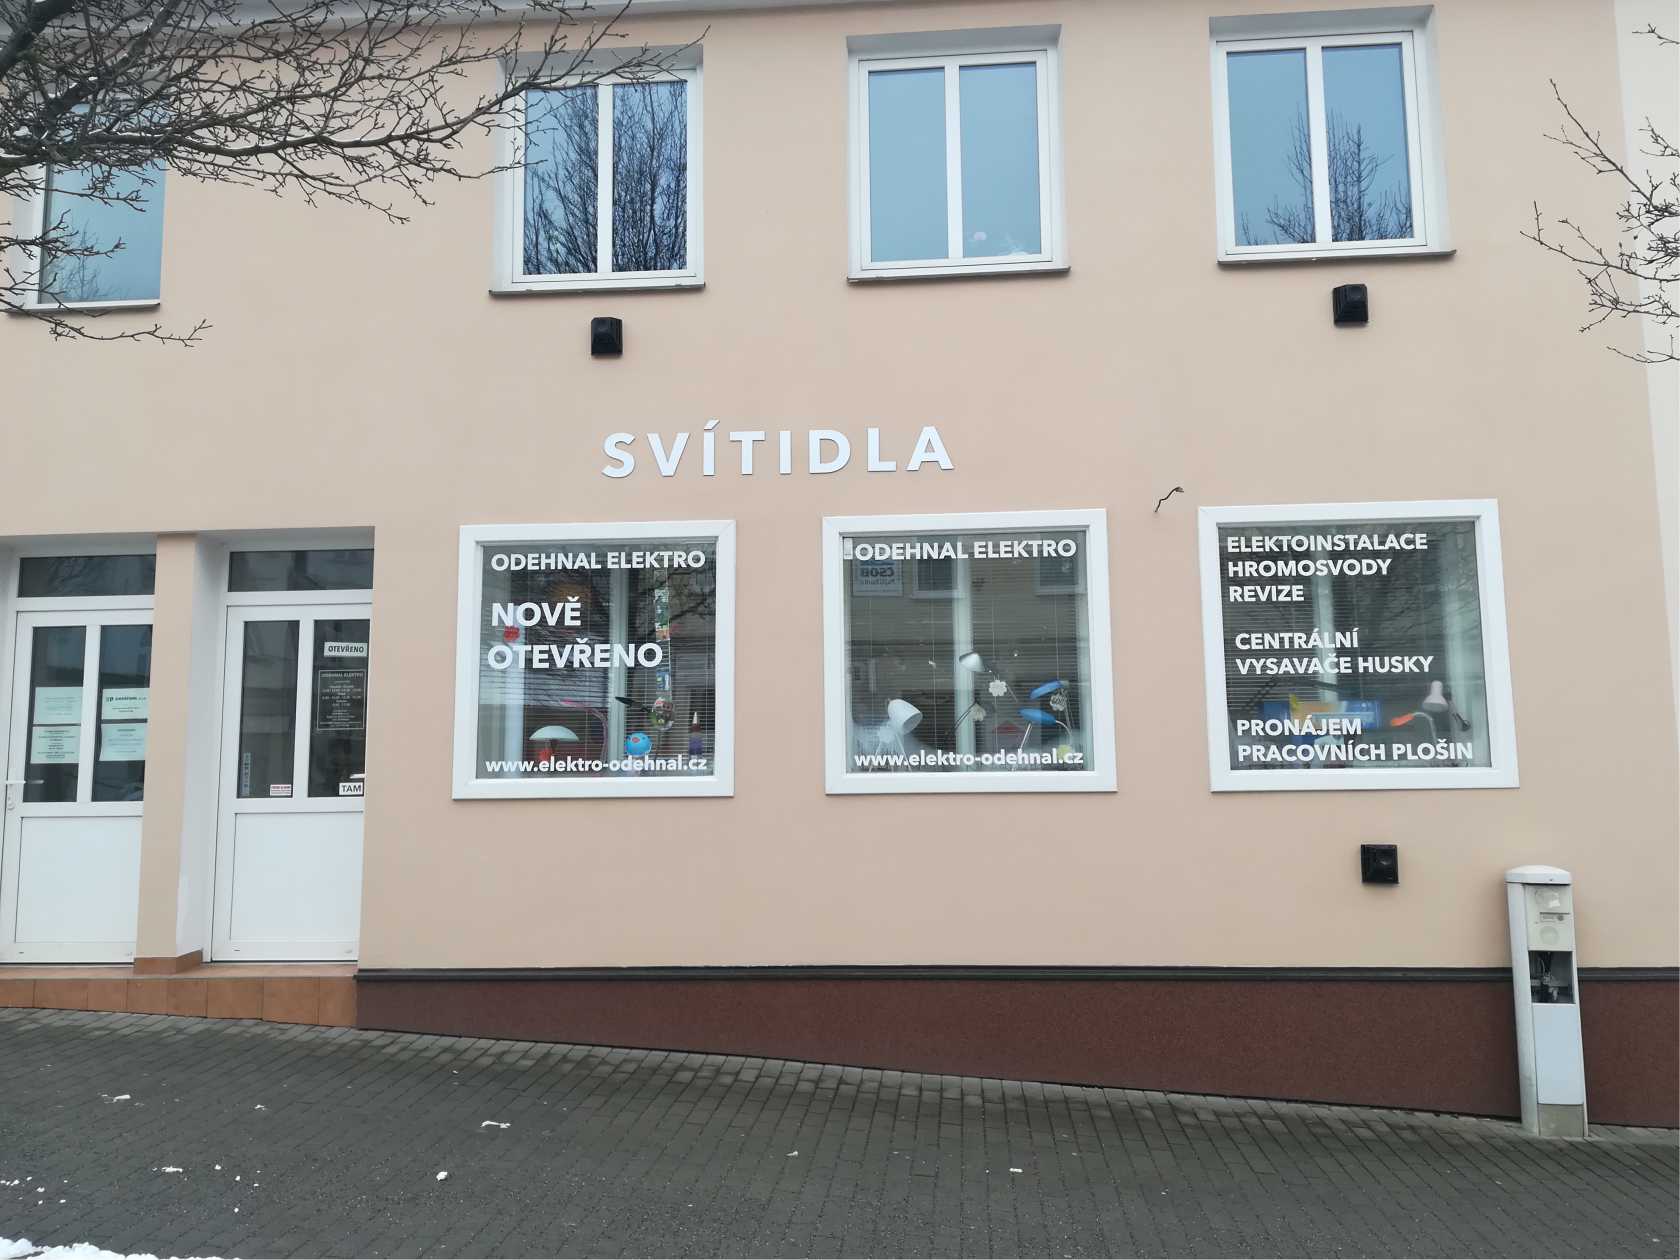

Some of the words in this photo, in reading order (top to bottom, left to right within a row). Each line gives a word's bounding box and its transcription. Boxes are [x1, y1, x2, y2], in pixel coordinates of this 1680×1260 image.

[601, 419, 954, 478] SVÍTIDLA
[855, 542, 968, 561] ODEHNAL
[973, 539, 1077, 558] ELEKTRO
[1227, 534, 1428, 553] ELEKTOINSTALACE
[491, 552, 601, 571] ODEHNAL
[606, 550, 706, 569] ELEKTRO
[1228, 559, 1392, 577] HROMOSVODY
[1229, 585, 1304, 602] REVIZE
[491, 596, 582, 626] NOVĚ
[1235, 628, 1359, 650] CENTRÁLNÍ
[487, 638, 663, 669] OTEVŘENO
[1236, 653, 1353, 675] VYSAVAČE
[1358, 656, 1434, 673] HUSKY
[1236, 714, 1362, 736] PRONÁJEM
[854, 748, 1084, 767] www.elektro-odehnal.cz
[1238, 740, 1386, 762] PRACOVNÍCH
[1392, 738, 1473, 760] PLOŠIN
[485, 755, 707, 773] www.elektro-odehnal.cz
[341, 784, 362, 793] TAM
